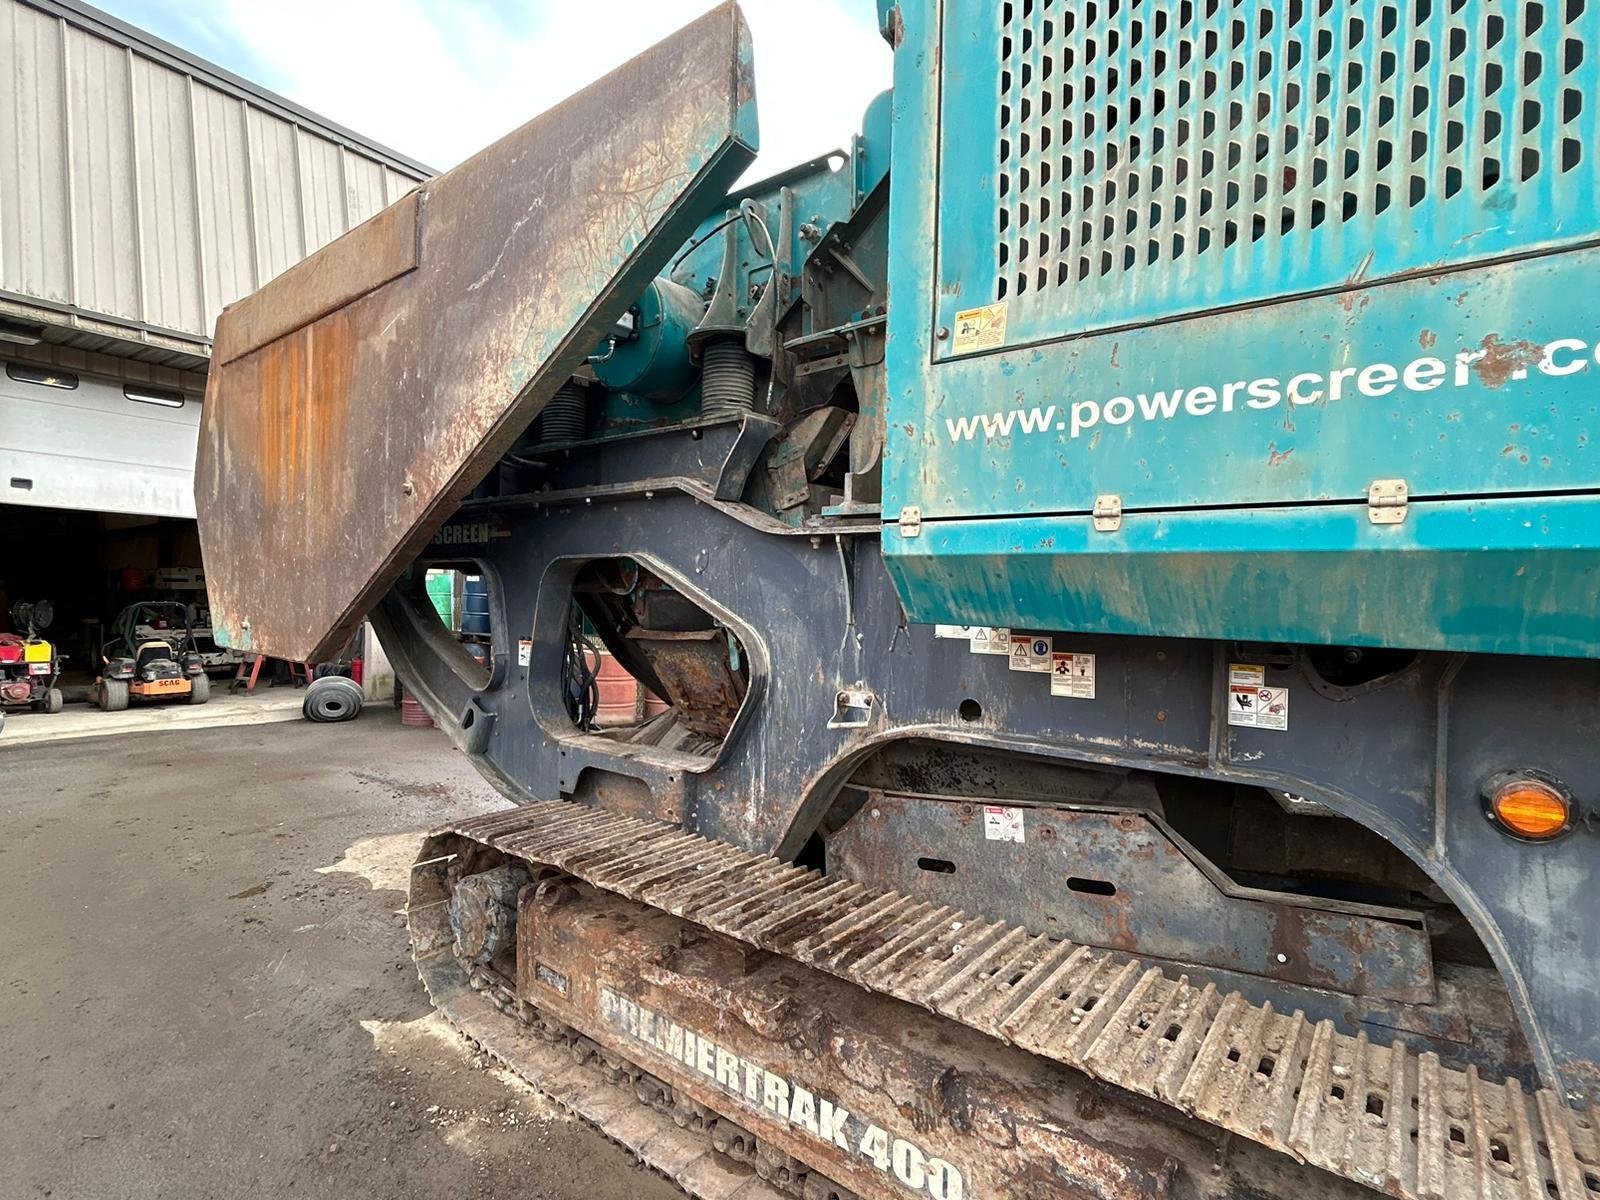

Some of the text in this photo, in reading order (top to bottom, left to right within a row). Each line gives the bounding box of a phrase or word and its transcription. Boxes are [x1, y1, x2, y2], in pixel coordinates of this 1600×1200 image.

[945, 338, 1600, 442] www.powerscree.c
[433, 523, 488, 545] SCREEN
[860, 1124, 963, 1200] 400
